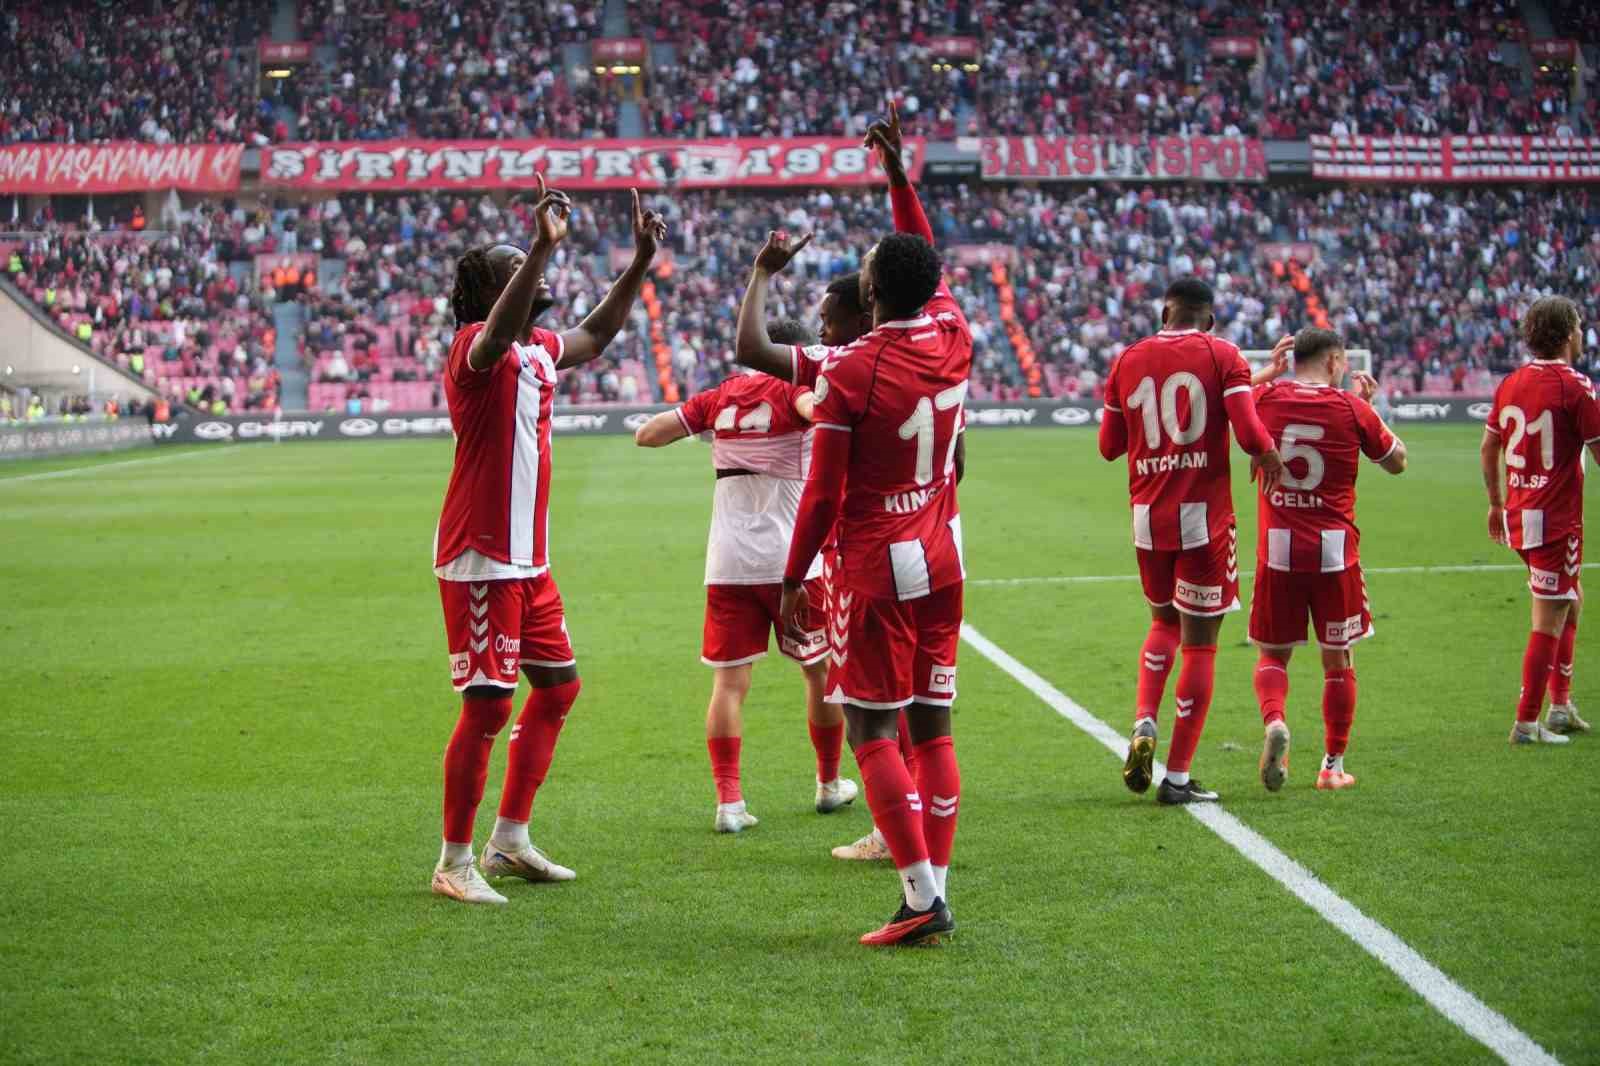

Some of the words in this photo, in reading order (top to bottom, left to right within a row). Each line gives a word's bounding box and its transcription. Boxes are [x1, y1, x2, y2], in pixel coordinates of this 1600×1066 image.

[964, 408, 1036, 424] HERY
[1127, 371, 1207, 450] 10
[1391, 403, 1451, 418] HERY
[237, 420, 323, 438] CHERY
[382, 417, 454, 435] CHER
[552, 414, 608, 432] ERY
[898, 379, 969, 486] 17
[1499, 405, 1554, 470] 21
[1136, 451, 1208, 475] NTCHAM
[1280, 423, 1325, 490] 5
[1177, 585, 1220, 601] onvo
